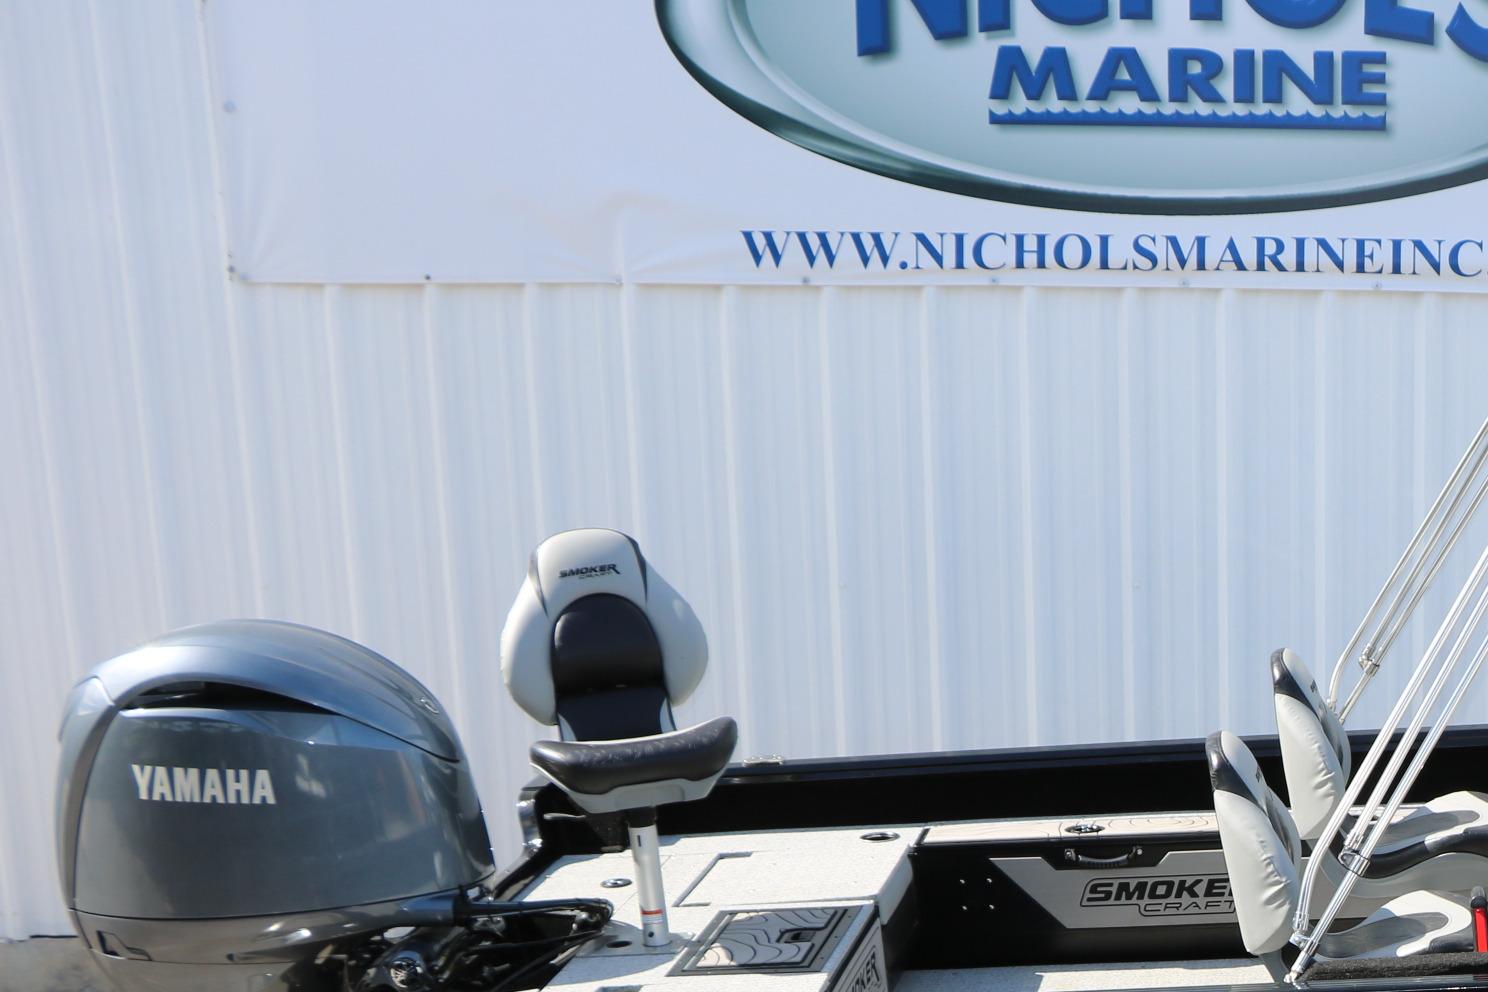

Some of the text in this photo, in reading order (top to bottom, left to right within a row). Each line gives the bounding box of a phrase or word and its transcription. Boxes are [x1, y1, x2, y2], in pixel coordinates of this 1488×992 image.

[989, 45, 1387, 106] MARINE
[559, 564, 620, 578] SMOKER
[132, 764, 276, 805] YAMAHA
[1086, 878, 1233, 902] SMOKE
[1143, 900, 1234, 912] CRAFT
